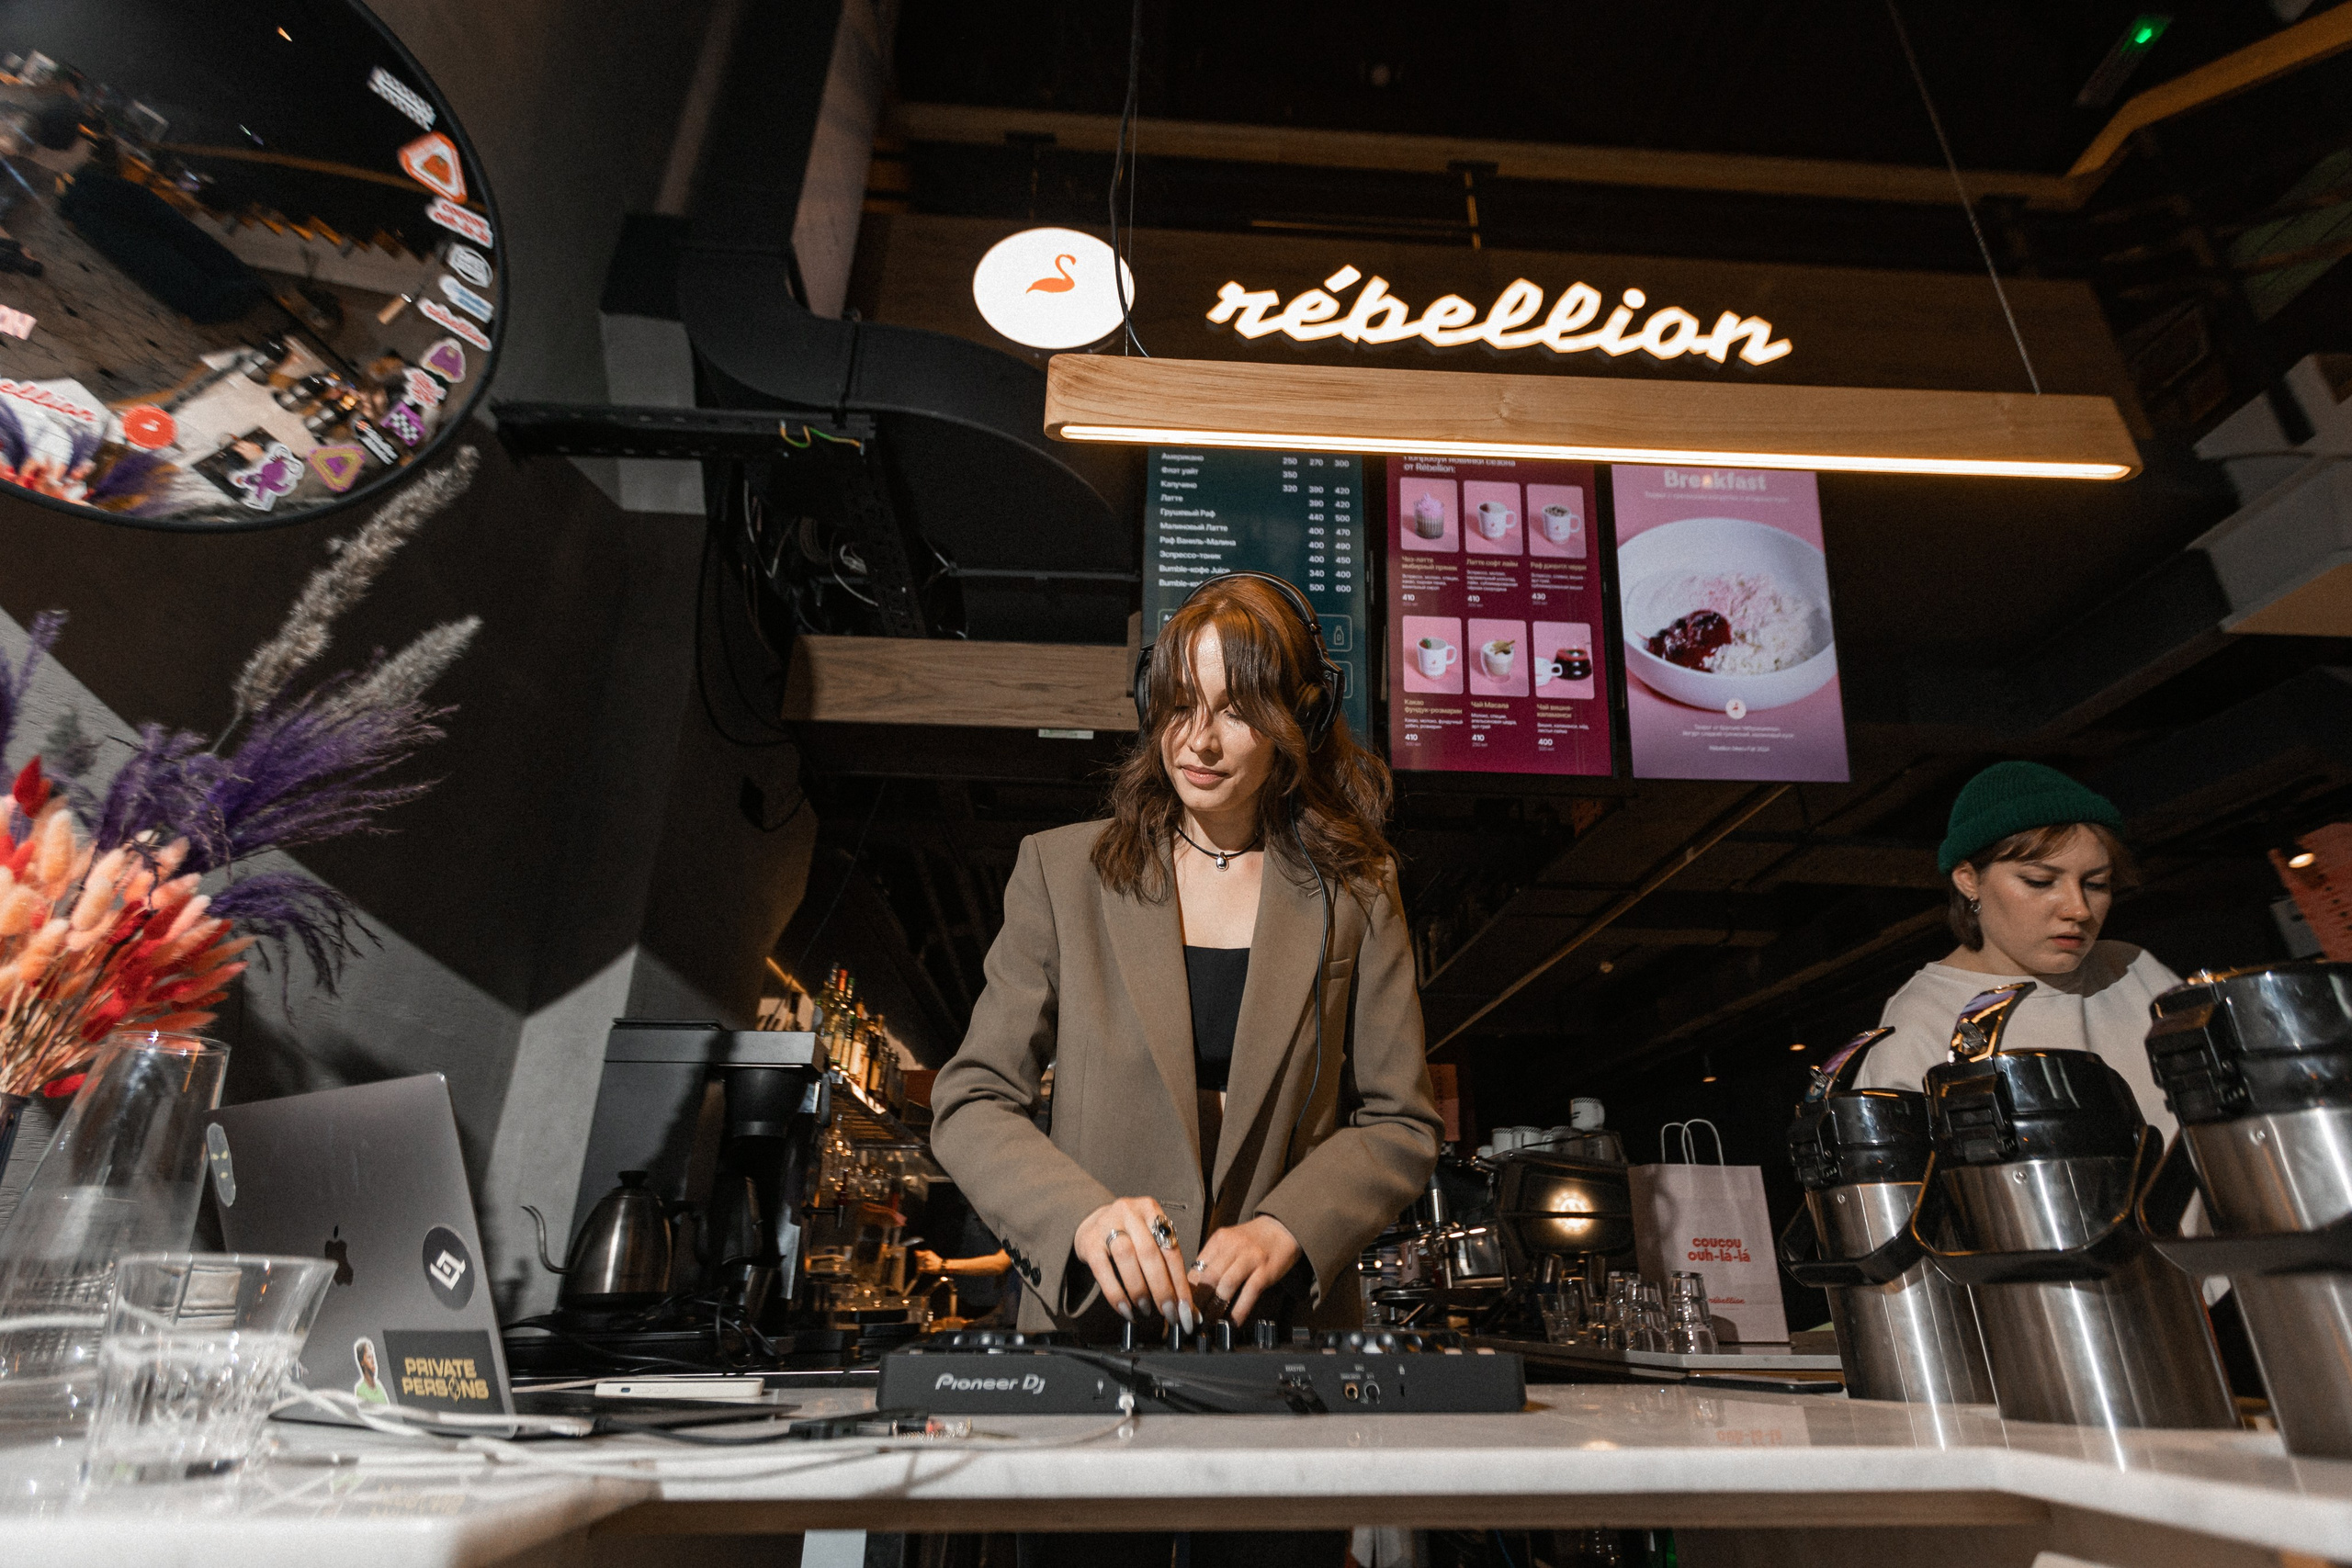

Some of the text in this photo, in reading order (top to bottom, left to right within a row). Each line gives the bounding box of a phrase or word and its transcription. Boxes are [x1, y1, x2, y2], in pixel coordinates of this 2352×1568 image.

[1207, 265, 1792, 366] rébellion
[1334, 459, 1350, 468] 300
[1283, 470, 1297, 479] 350
[1664, 468, 1767, 491] Breakfast
[1283, 484, 1297, 492] 320
[1334, 487, 1350, 495] 420
[1160, 493, 1183, 502] Латте
[1335, 501, 1351, 509] 420
[1200, 509, 1216, 518] Раф
[1308, 513, 1351, 523] 440 500
[1159, 522, 1228, 532] Малиновый Латте
[1308, 527, 1351, 536] 400 470
[1159, 536, 1175, 545] Раф
[1308, 541, 1351, 550] 400 490
[1159, 550, 1222, 560] Эспрессо-тоник
[1308, 555, 1351, 565] 400 450
[1159, 564, 1210, 574] Bumble-кофе
[1309, 570, 1351, 579] 340 400
[1309, 583, 1351, 592] 500 600
[1402, 593, 1415, 602] 410
[1467, 594, 1480, 603] 410
[1532, 592, 1546, 601] 430
[1484, 701, 1510, 709] Масала
[1405, 733, 1419, 741] 410
[1472, 734, 1485, 742] 410
[1538, 738, 1554, 746] 400
[1692, 1237, 1742, 1248] coucou
[1688, 1247, 1751, 1263] ouh-lá-lá
[404, 1357, 478, 1378] PRIVATE
[935, 1372, 1018, 1391] Pioneer
[401, 1376, 490, 1403] PERSONS
